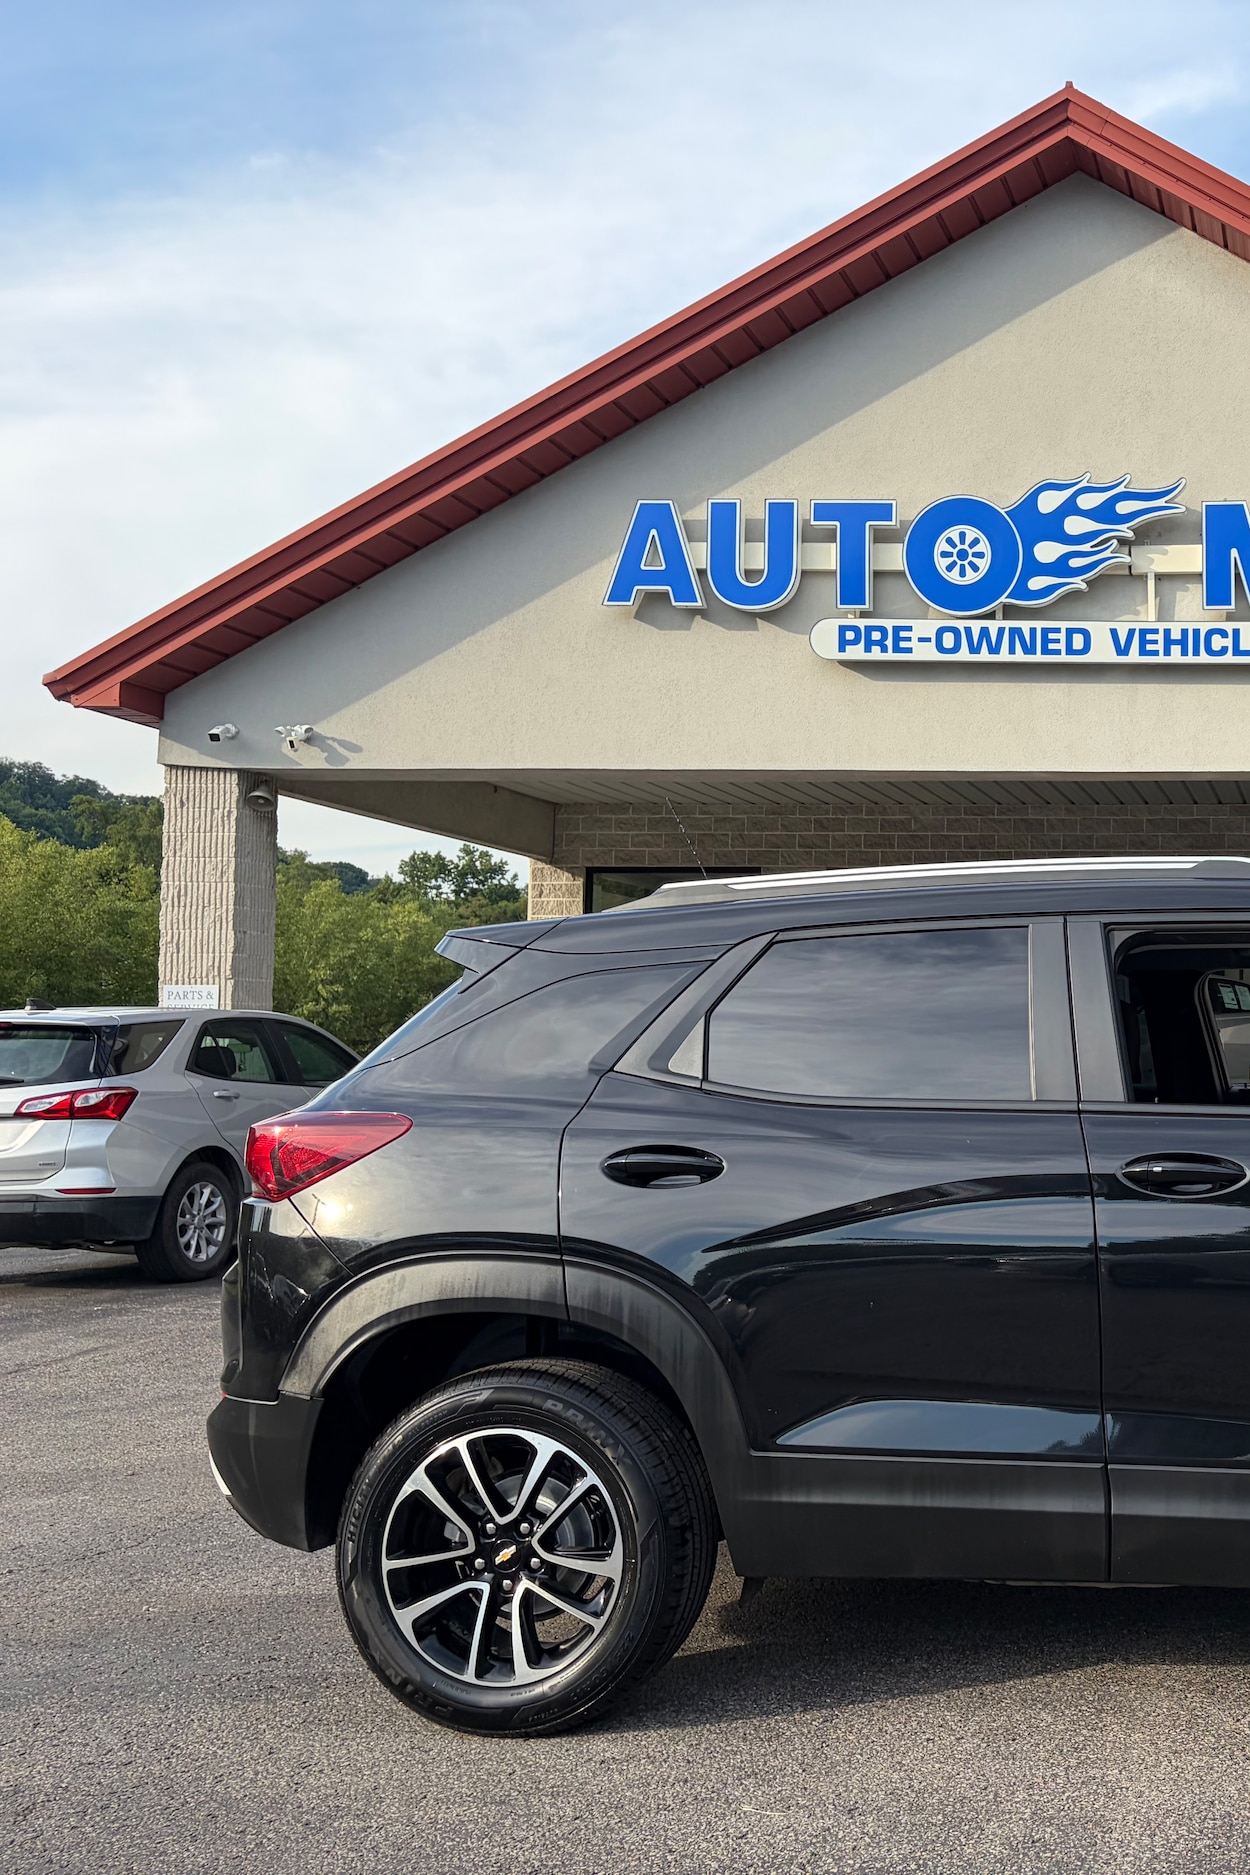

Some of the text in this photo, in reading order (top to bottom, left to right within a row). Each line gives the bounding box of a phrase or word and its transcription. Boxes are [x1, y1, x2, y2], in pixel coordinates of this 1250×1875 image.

[601, 492, 1024, 618] AUTO
[836, 623, 1094, 658] PRE-OWNED
[167, 990, 215, 1000] PARTS &
